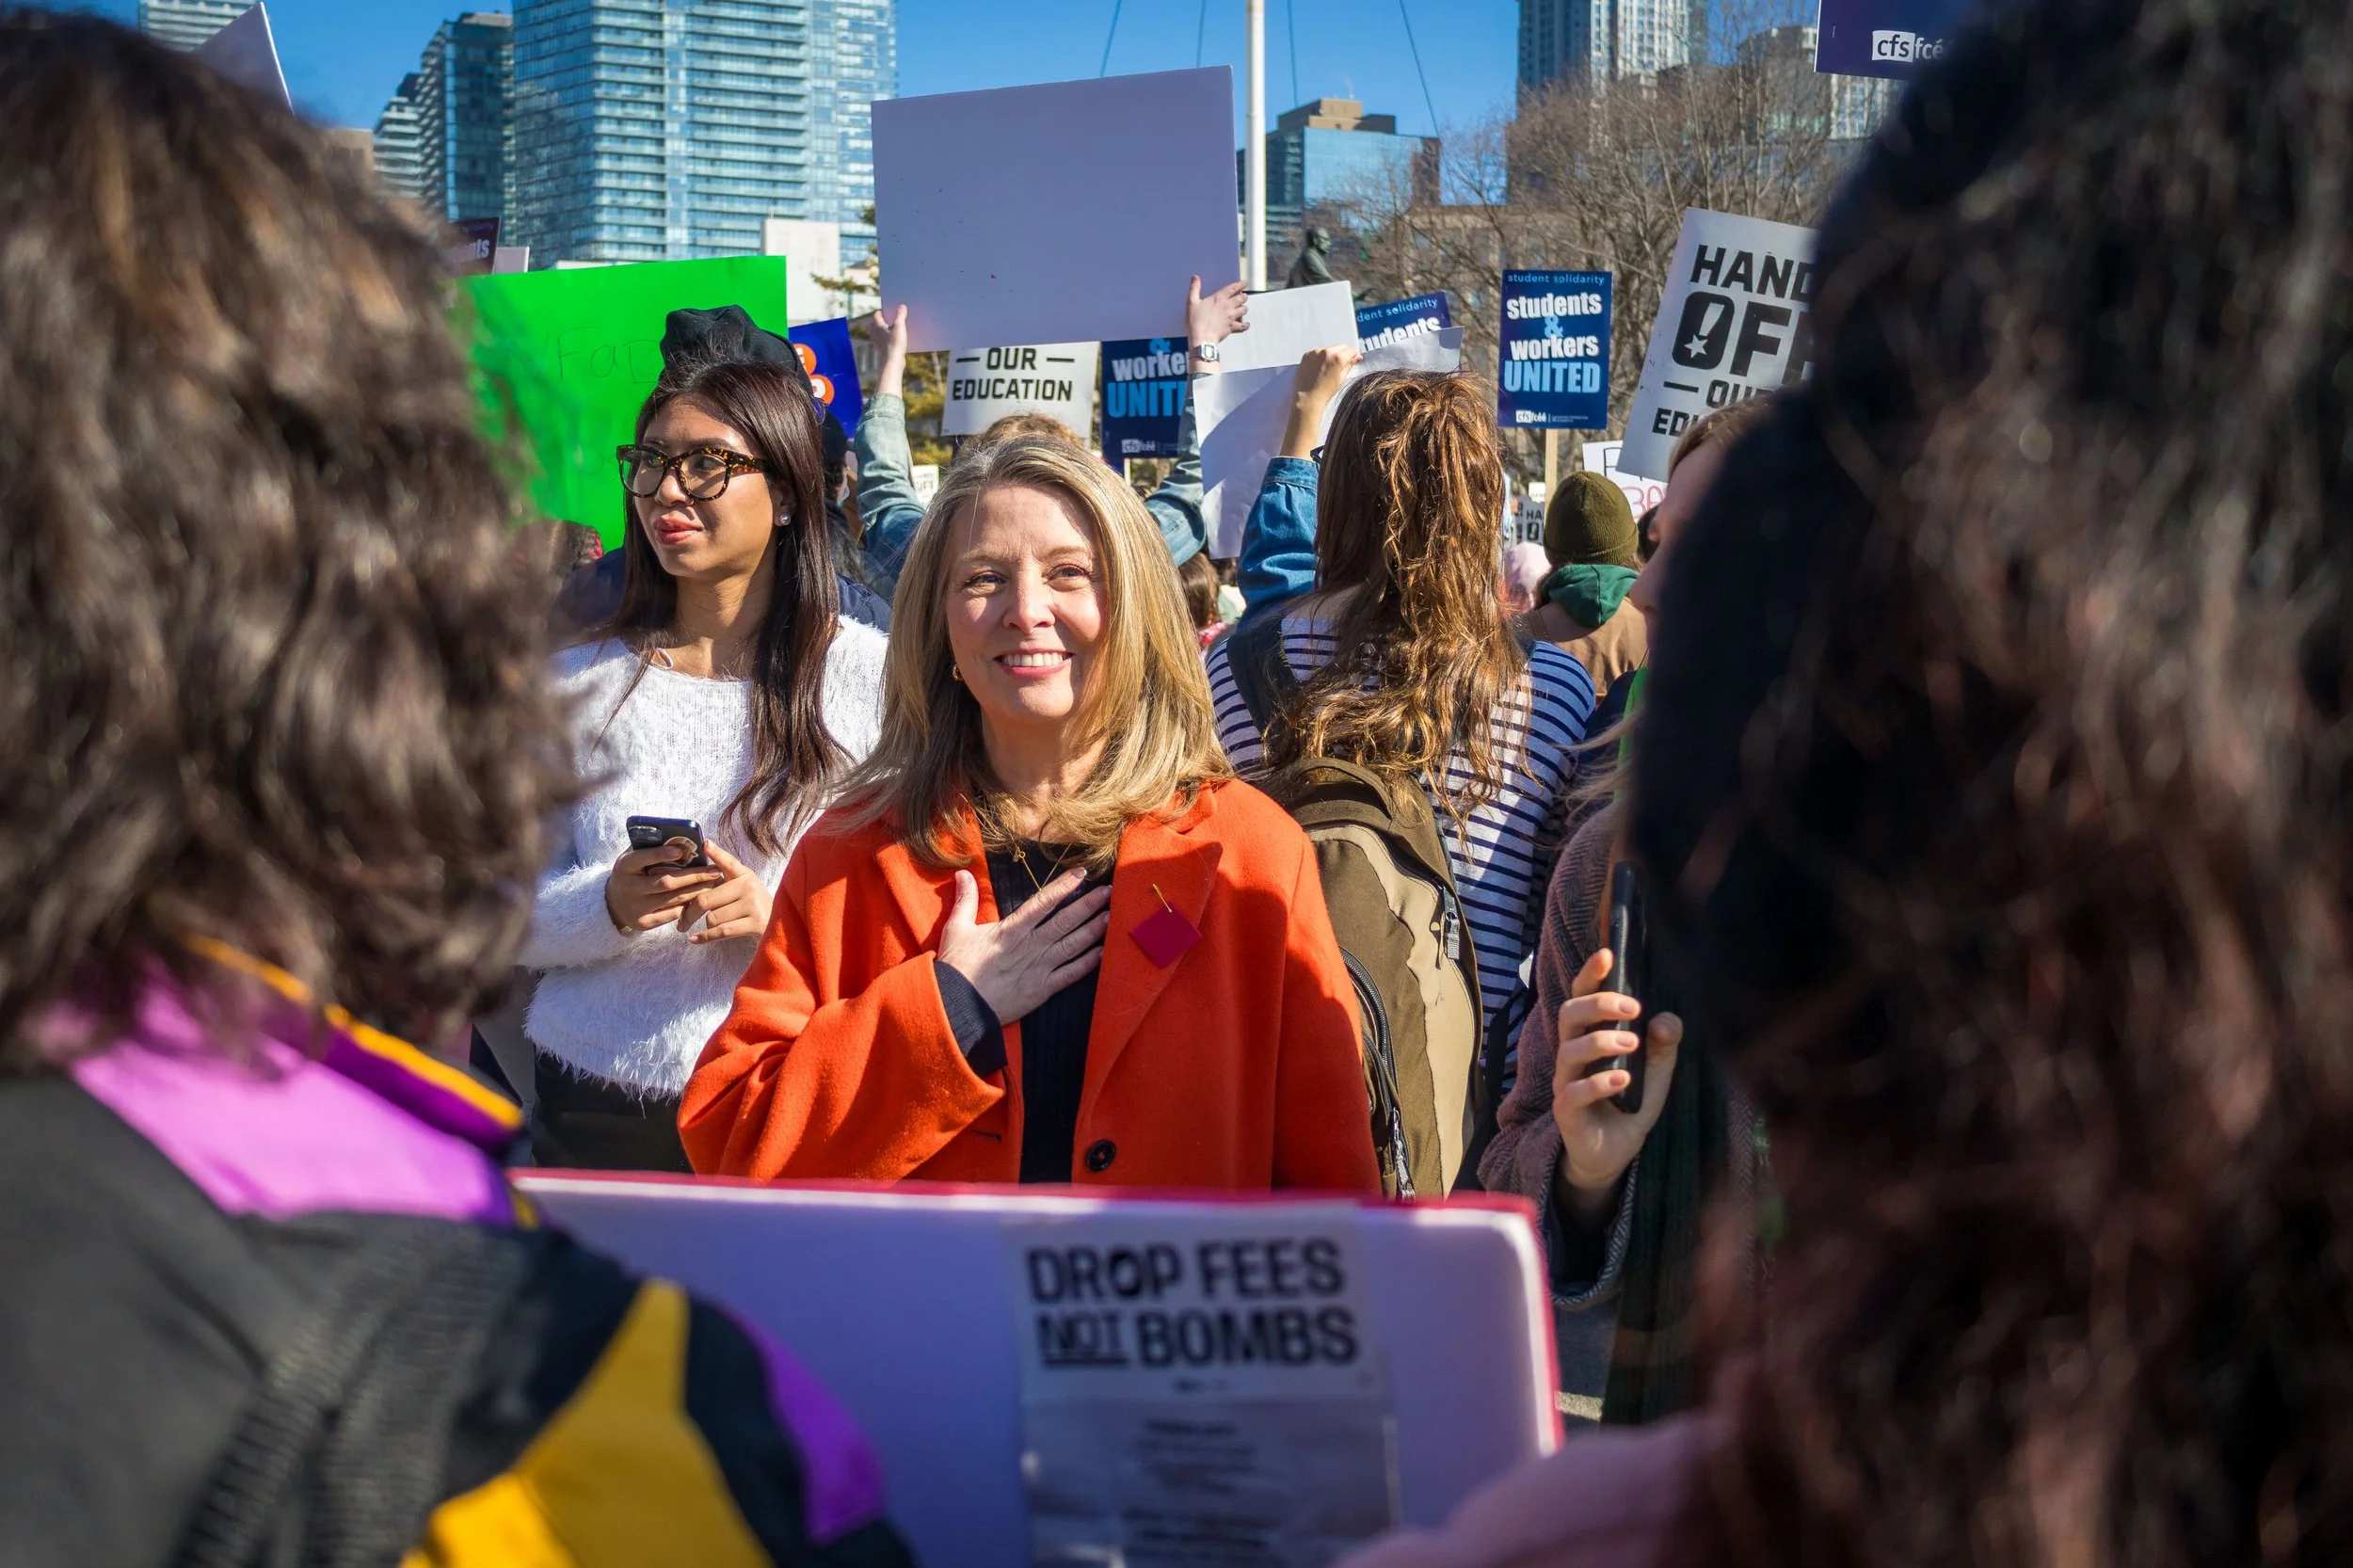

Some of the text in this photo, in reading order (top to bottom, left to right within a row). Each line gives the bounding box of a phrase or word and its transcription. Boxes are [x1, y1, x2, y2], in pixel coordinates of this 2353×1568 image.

[1915, 38, 1945, 59] fcé
[1508, 273, 1604, 286] student solidarity
[1690, 245, 1817, 303] HAND
[1357, 297, 1437, 323] dent solidarity
[1506, 292, 1602, 319] students
[1359, 317, 1441, 352] tudents
[1544, 314, 1563, 339] &
[986, 347, 1036, 370] OUR
[1510, 334, 1598, 361] workers
[952, 378, 1072, 401] EDUCATION
[1503, 360, 1600, 392] UNITED
[1027, 1237, 1345, 1303] DROP FEES
[1038, 1306, 1358, 1368] NOT BOMBS
